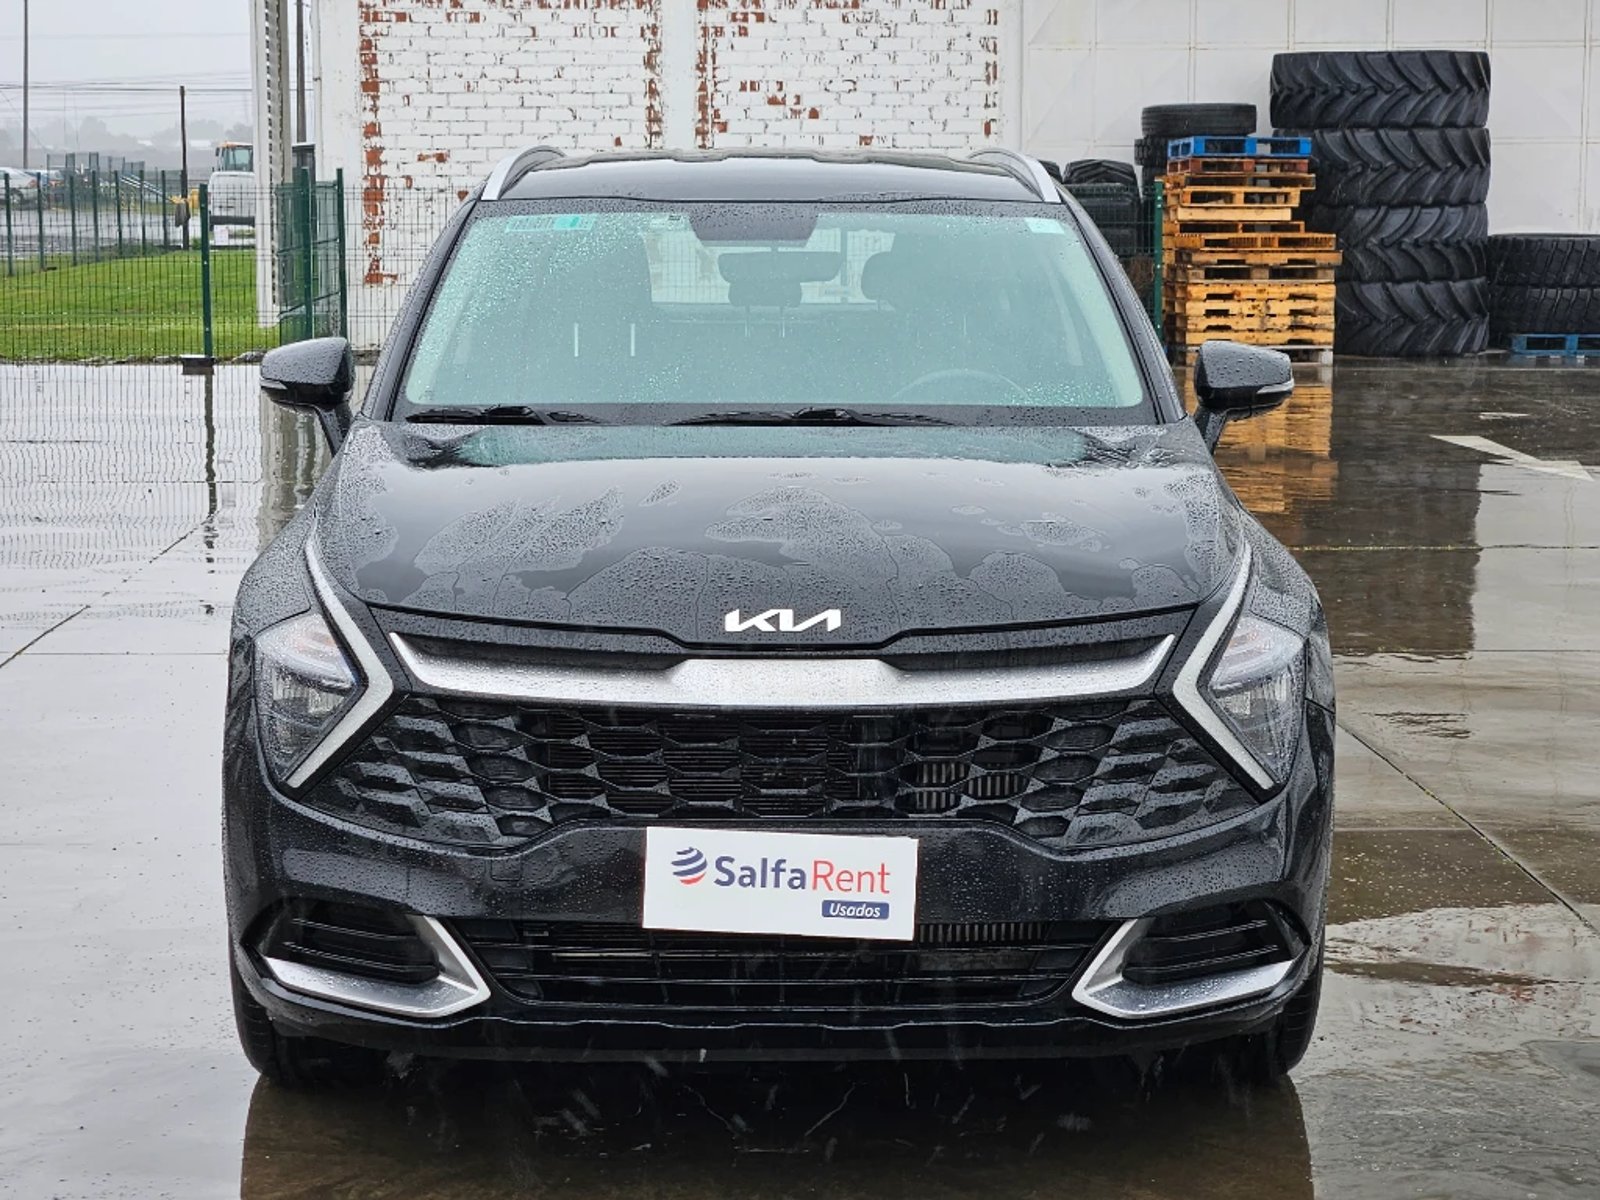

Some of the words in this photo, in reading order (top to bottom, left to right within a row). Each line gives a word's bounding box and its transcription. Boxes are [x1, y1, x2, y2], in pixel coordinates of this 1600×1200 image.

[724, 608, 842, 632] KIA
[713, 855, 891, 894] SalfaRent
[829, 902, 881, 918] Usados
